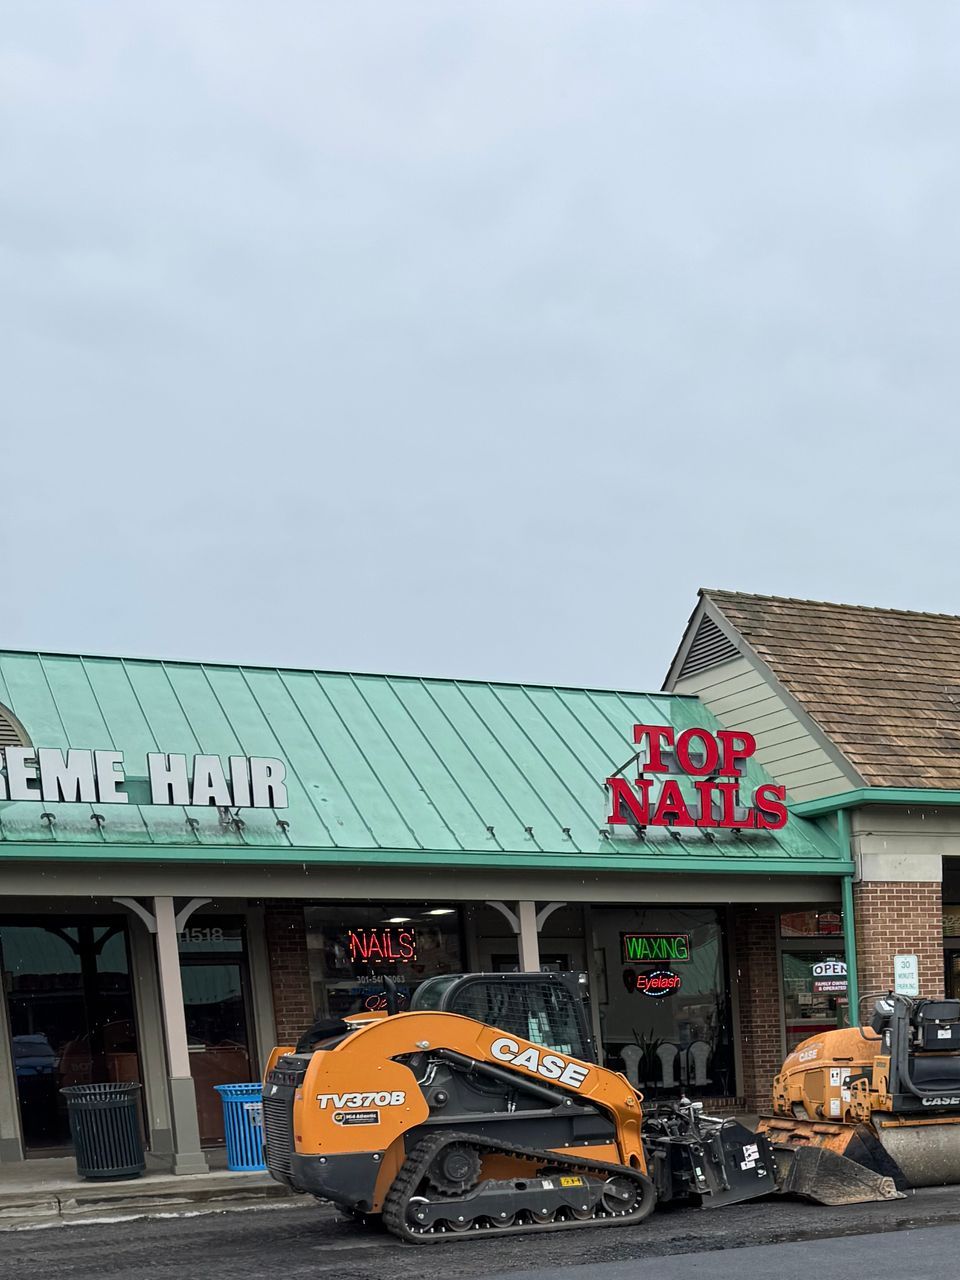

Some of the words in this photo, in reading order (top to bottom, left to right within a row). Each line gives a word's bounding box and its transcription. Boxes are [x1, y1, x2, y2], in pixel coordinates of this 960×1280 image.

[632, 724, 757, 777] TOP
[0, 747, 129, 804] EME
[147, 752, 289, 809] HAIR
[605, 777, 789, 830] NAILS
[351, 933, 414, 959] NAILS
[626, 937, 689, 960] WAXING
[900, 960, 911, 969] 30
[636, 975, 681, 992] Eyelash
[490, 1037, 590, 1089] CASE
[799, 1049, 818, 1062] CASE
[317, 1091, 406, 1109] TV370B
[922, 1097, 960, 1106] CASE
